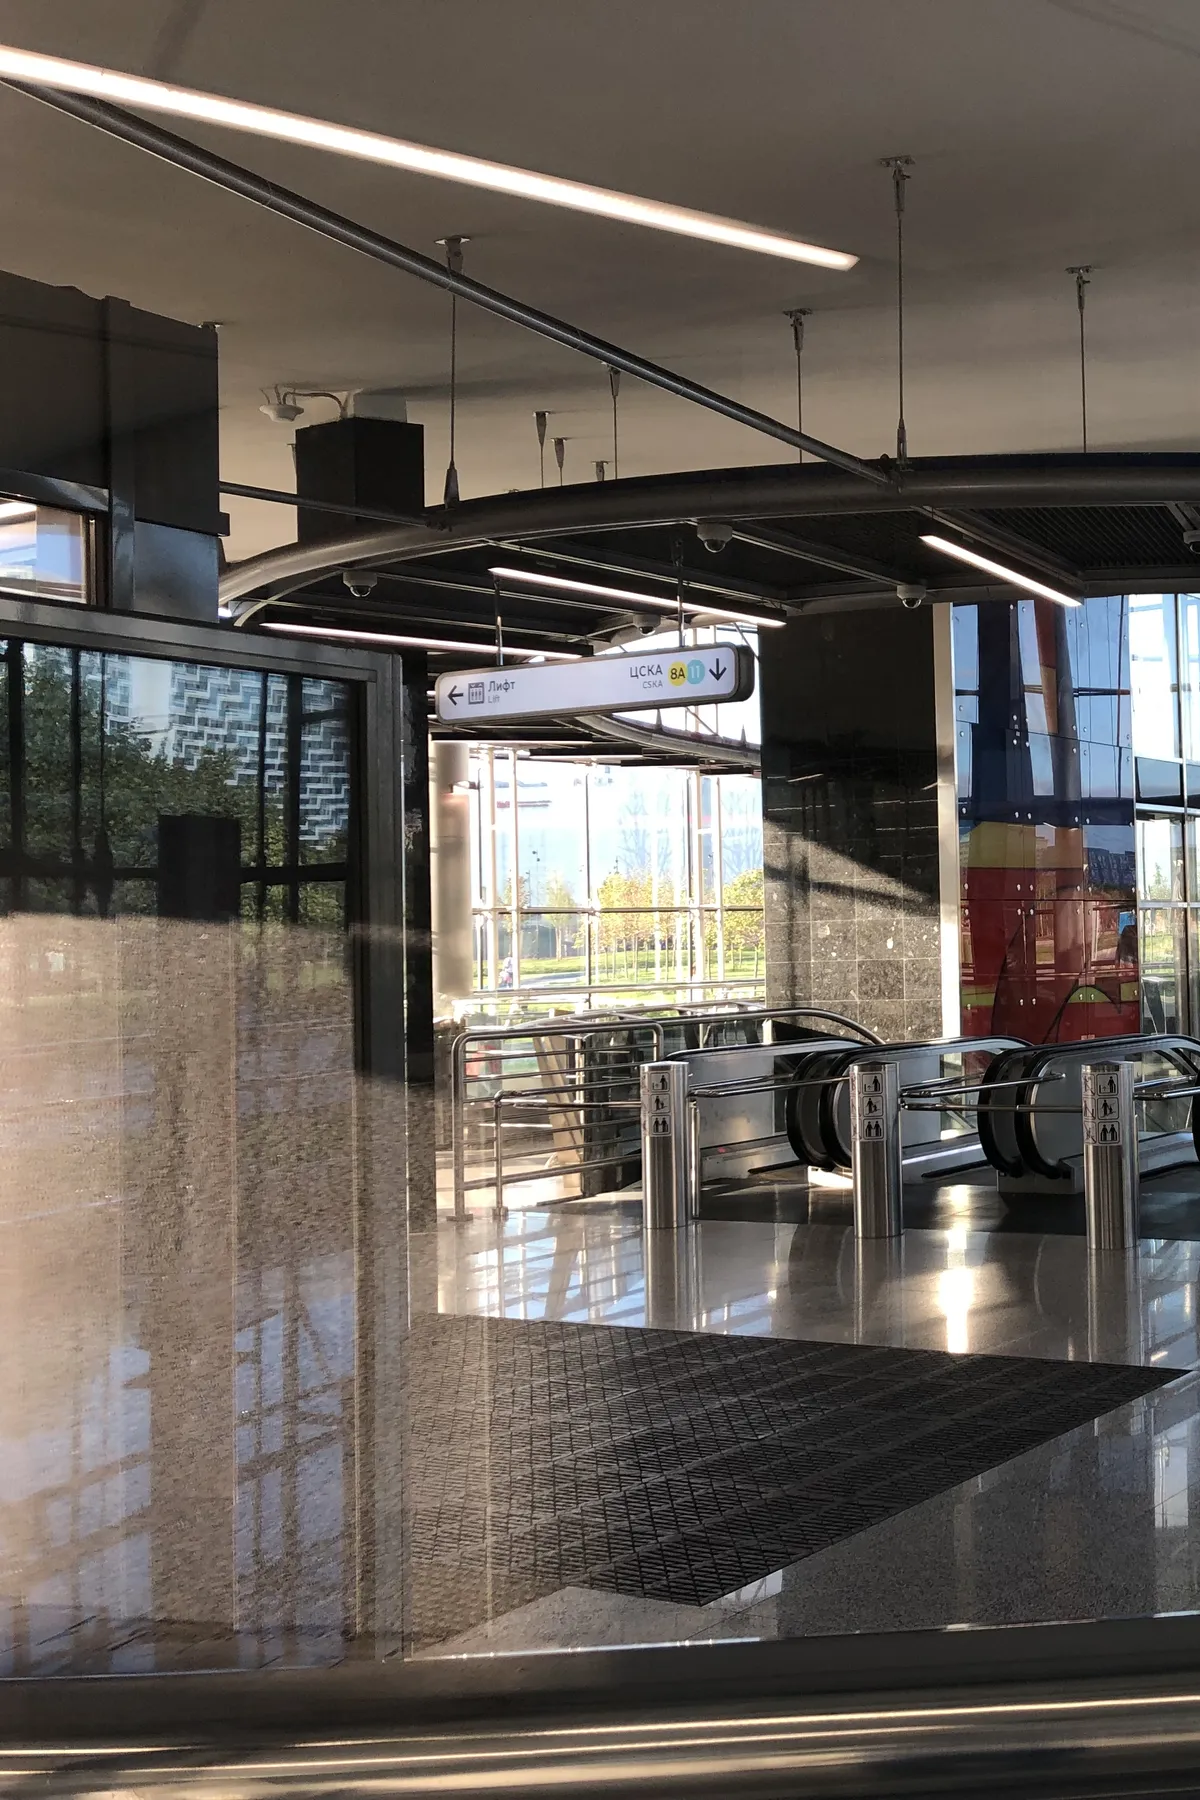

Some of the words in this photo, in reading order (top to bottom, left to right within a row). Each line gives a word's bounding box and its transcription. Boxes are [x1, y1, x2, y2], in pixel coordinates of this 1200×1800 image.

[629, 664, 663, 679] ЦСКА
[690, 665, 701, 679] 11
[488, 679, 515, 692] Лифт
[643, 680, 663, 689] CSKA
